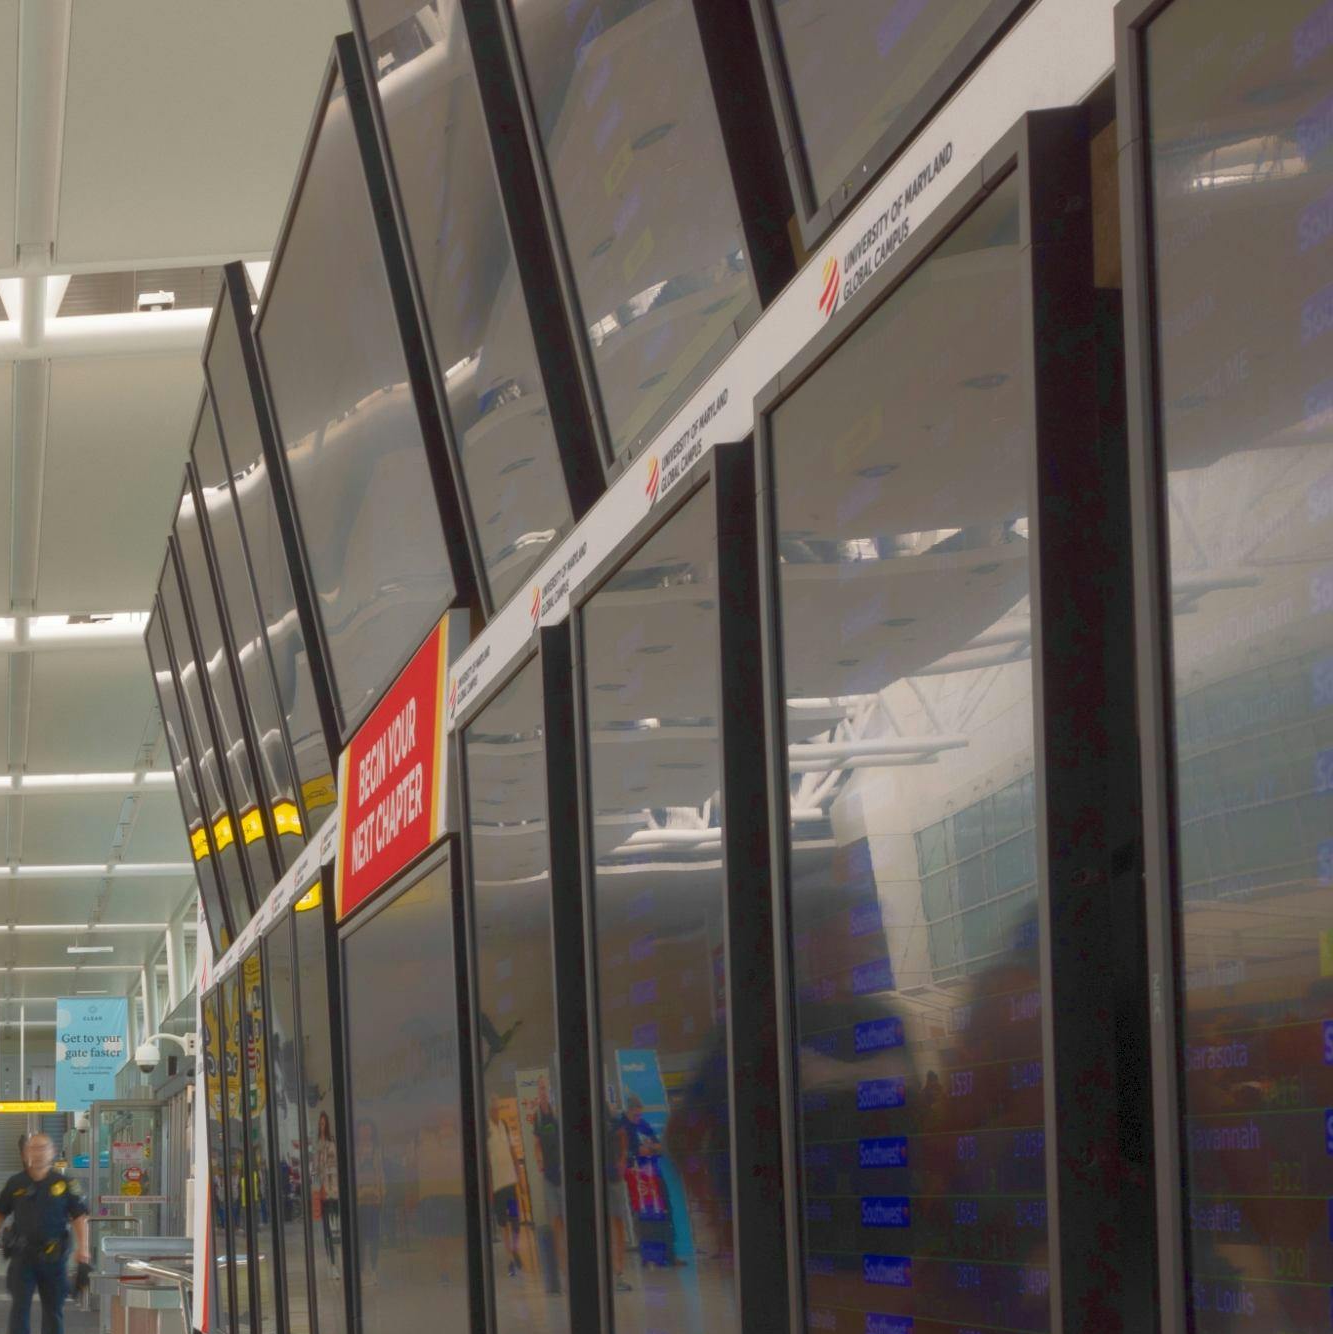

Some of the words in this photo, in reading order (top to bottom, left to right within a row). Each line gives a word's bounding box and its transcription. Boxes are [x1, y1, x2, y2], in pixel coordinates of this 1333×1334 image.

[844, 210, 890, 274] UNIVERSITY
[890, 194, 903, 222] OF
[904, 141, 953, 209] MARYLAND
[843, 257, 873, 301] GLOBAL
[874, 217, 910, 269] CAMPUS
[358, 732, 386, 808] BEGIN
[387, 696, 416, 774] YOUR
[351, 811, 375, 876] NEXT
[375, 762, 423, 853] CHAPTER
[62, 1033, 81, 1043] Get
[83, 1034, 94, 1043] to
[96, 1035, 121, 1045] your
[65, 1049, 88, 1060] gate
[90, 1047, 122, 1057] faster
[859, 1139, 901, 1166] Southwest
[862, 1202, 903, 1226] Southwest
[1190, 1203, 1241, 1232] Seattle
[864, 1259, 905, 1284] Southwest
[1217, 1282, 1255, 1315] Louis
